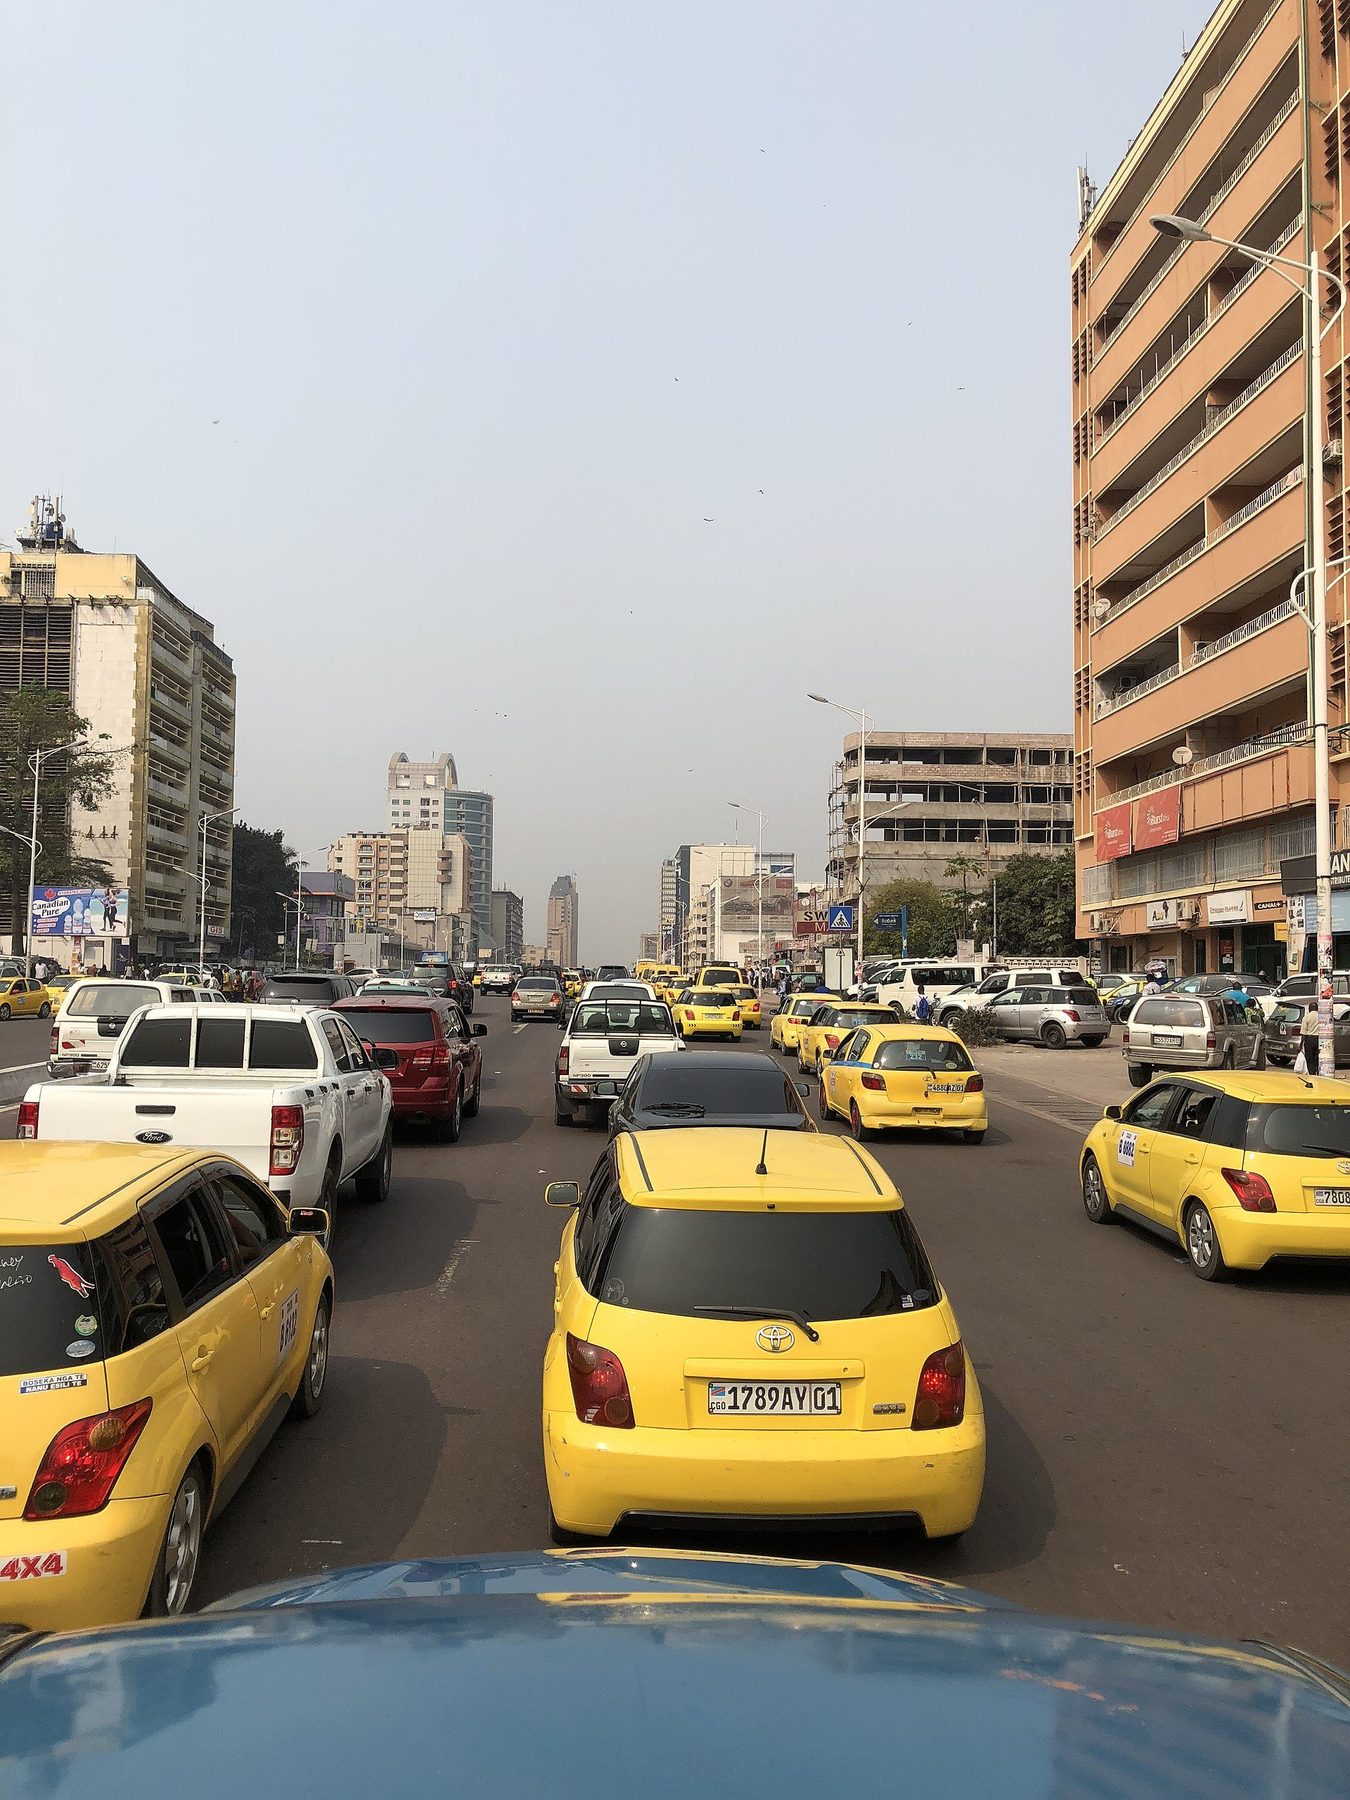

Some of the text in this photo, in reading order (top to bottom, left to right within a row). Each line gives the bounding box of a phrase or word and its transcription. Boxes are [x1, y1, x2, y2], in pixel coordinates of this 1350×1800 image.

[1330, 852, 1350, 874] AN
[32, 899, 69, 911] Canadian
[41, 908, 60, 917] Pure
[96, 1062, 110, 1070] 625
[143, 1131, 164, 1142] Ford
[1324, 1190, 1350, 1204] 7808
[23, 1376, 55, 1387] BOSEKA
[56, 1374, 73, 1382] NGA
[25, 1384, 49, 1393] NANU
[727, 1385, 839, 1411] 1789AY 01
[710, 1401, 726, 1411] CGO
[0, 1552, 64, 1581] 4X4
